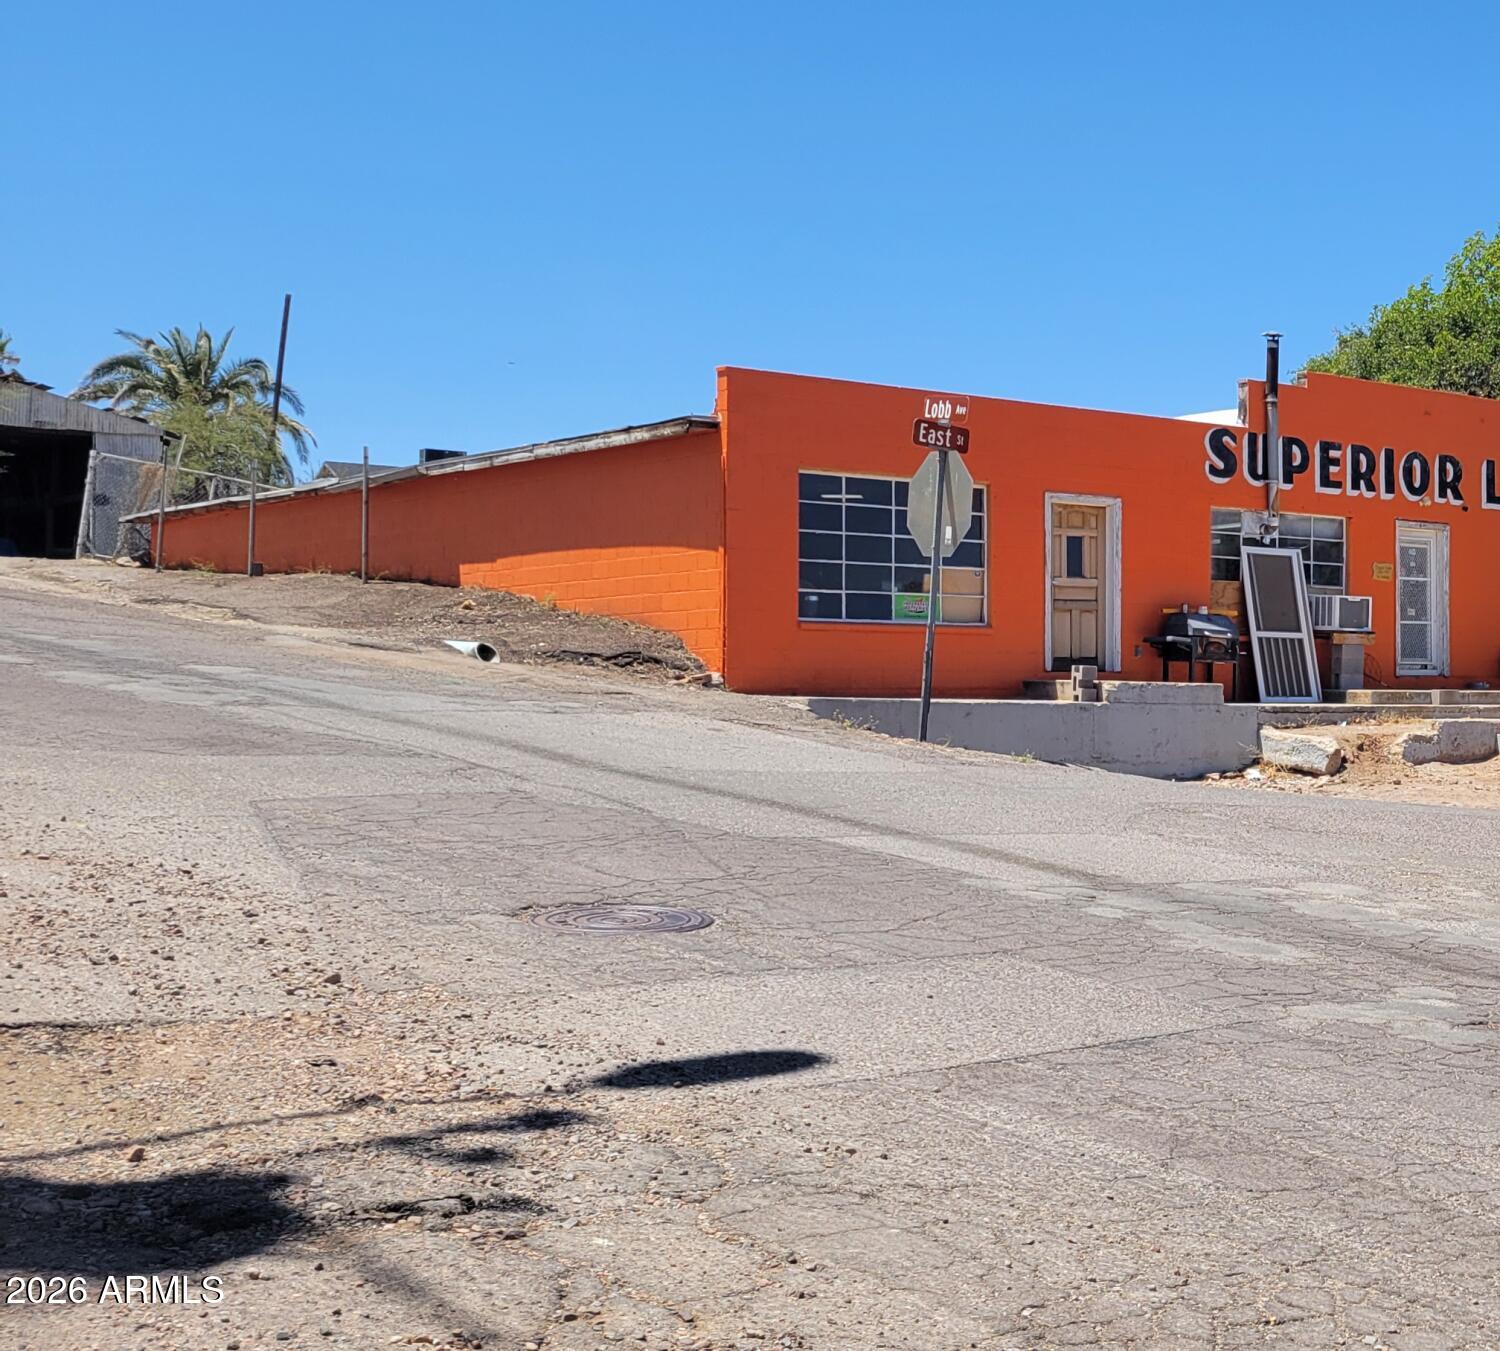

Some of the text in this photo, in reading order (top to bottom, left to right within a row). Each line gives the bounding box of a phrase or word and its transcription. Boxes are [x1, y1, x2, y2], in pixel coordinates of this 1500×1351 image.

[924, 399, 967, 419] Lobb Ave
[918, 422, 951, 448] East
[1204, 427, 1465, 506] SUPERIOR
